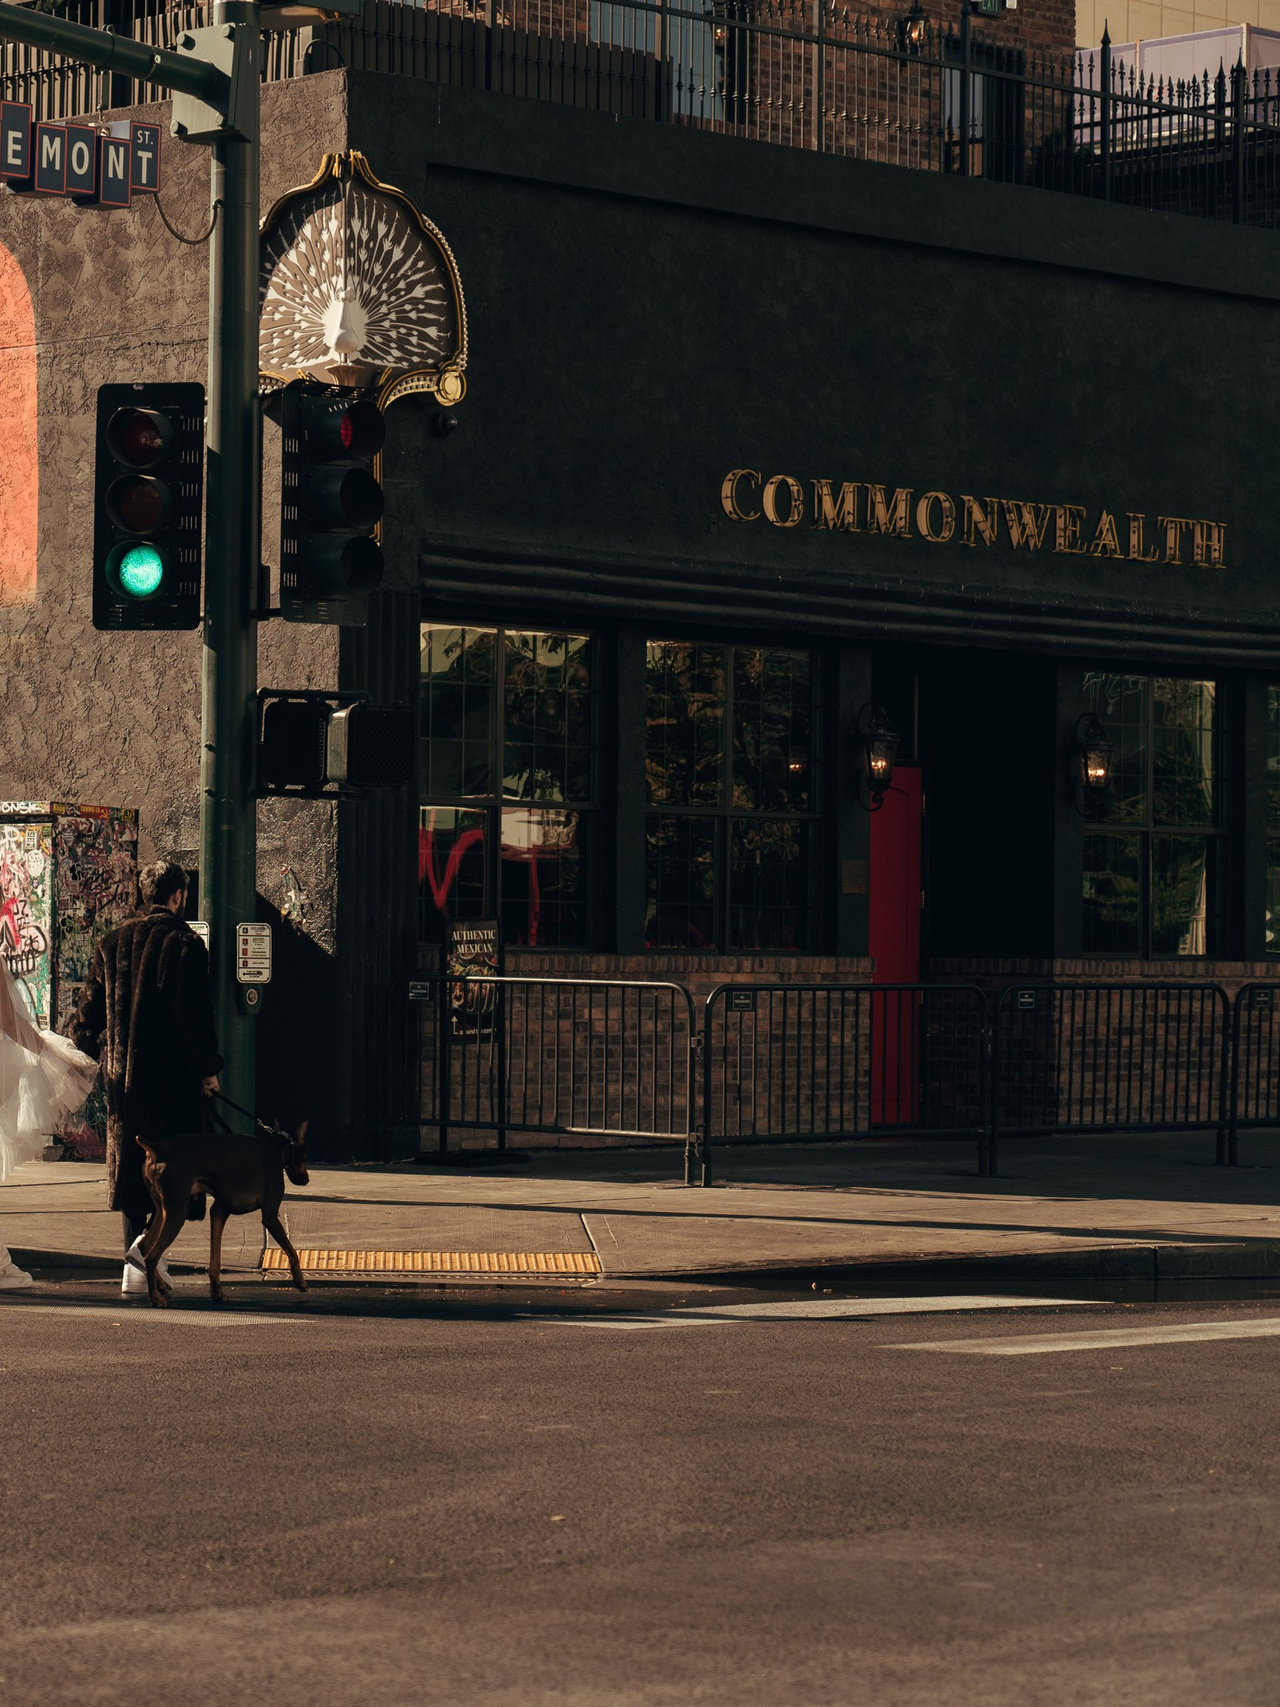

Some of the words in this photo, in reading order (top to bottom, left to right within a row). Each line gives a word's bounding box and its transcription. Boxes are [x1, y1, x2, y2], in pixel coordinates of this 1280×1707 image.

[137, 130, 154, 145] ST.
[721, 468, 1227, 569] COMMONWEALTH
[452, 930, 496, 940] AUTHENTIC
[457, 943, 492, 953] MEXICAN
